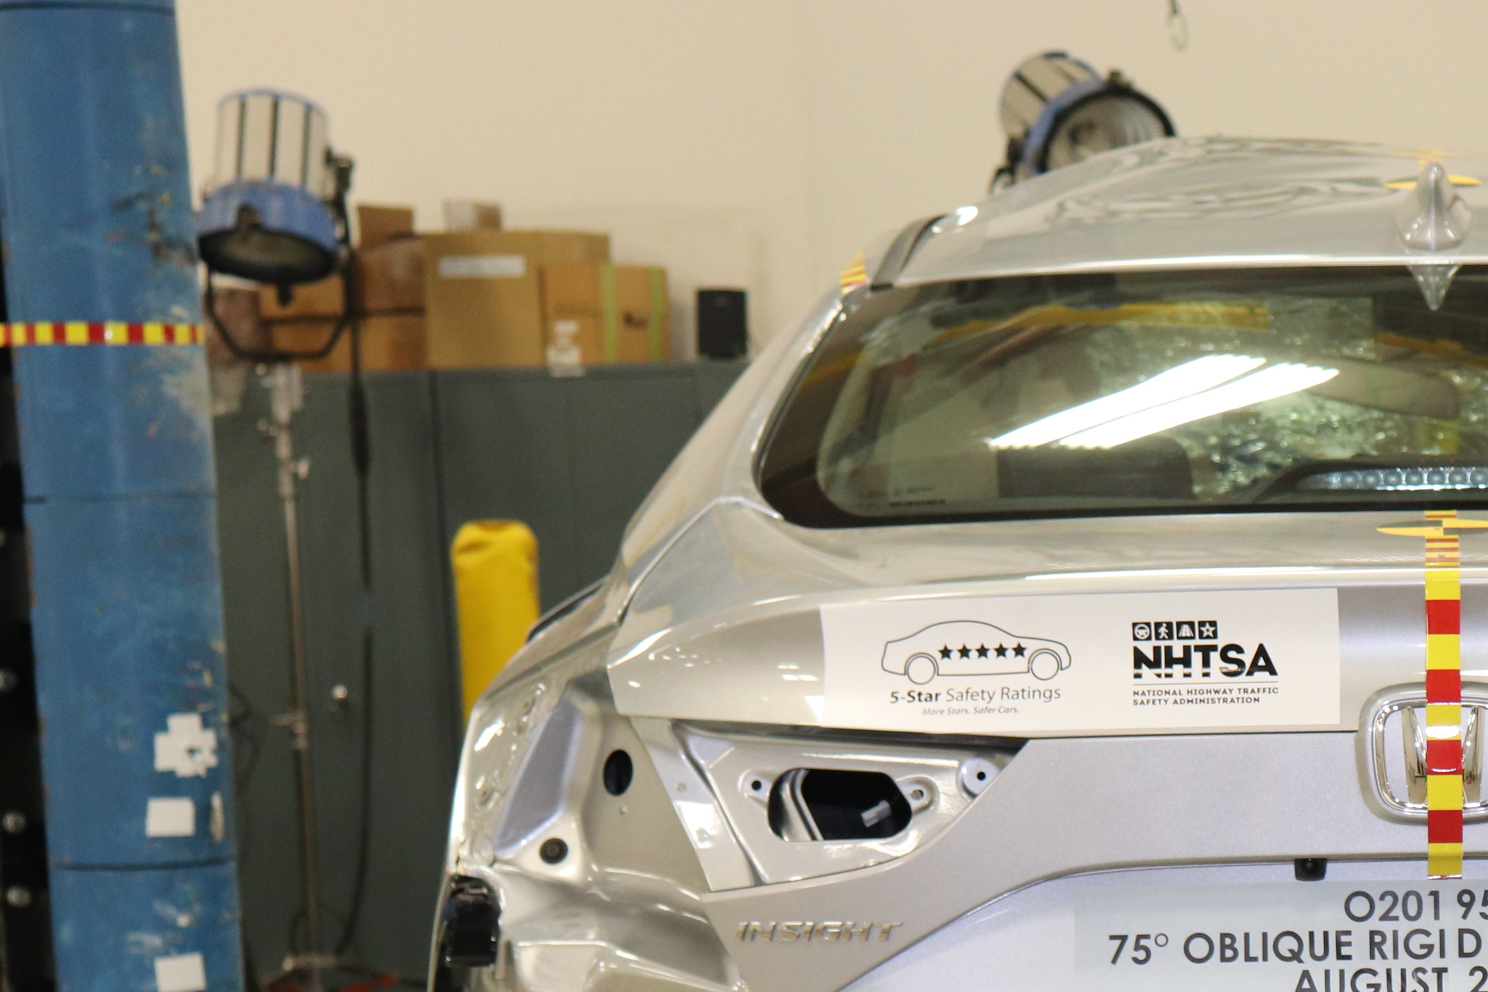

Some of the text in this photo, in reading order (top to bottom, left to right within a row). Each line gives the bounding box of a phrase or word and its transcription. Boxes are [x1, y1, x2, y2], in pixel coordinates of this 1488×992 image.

[1133, 643, 1279, 679] NHTSA
[890, 686, 1062, 704] 5-Star Safety Ratings
[1133, 687, 1279, 697] NATIONAL HIGHWAY TRAFFIC
[1133, 696, 1260, 706] SAFETY ADMINISTRATION
[922, 705, 1020, 716] More Stars. Safer Cars.
[735, 920, 903, 943] INSIGHT
[1108, 932, 1169, 966] 75°
[1183, 930, 1353, 964] OBLIQUE
[1369, 928, 1482, 961] RIGID
